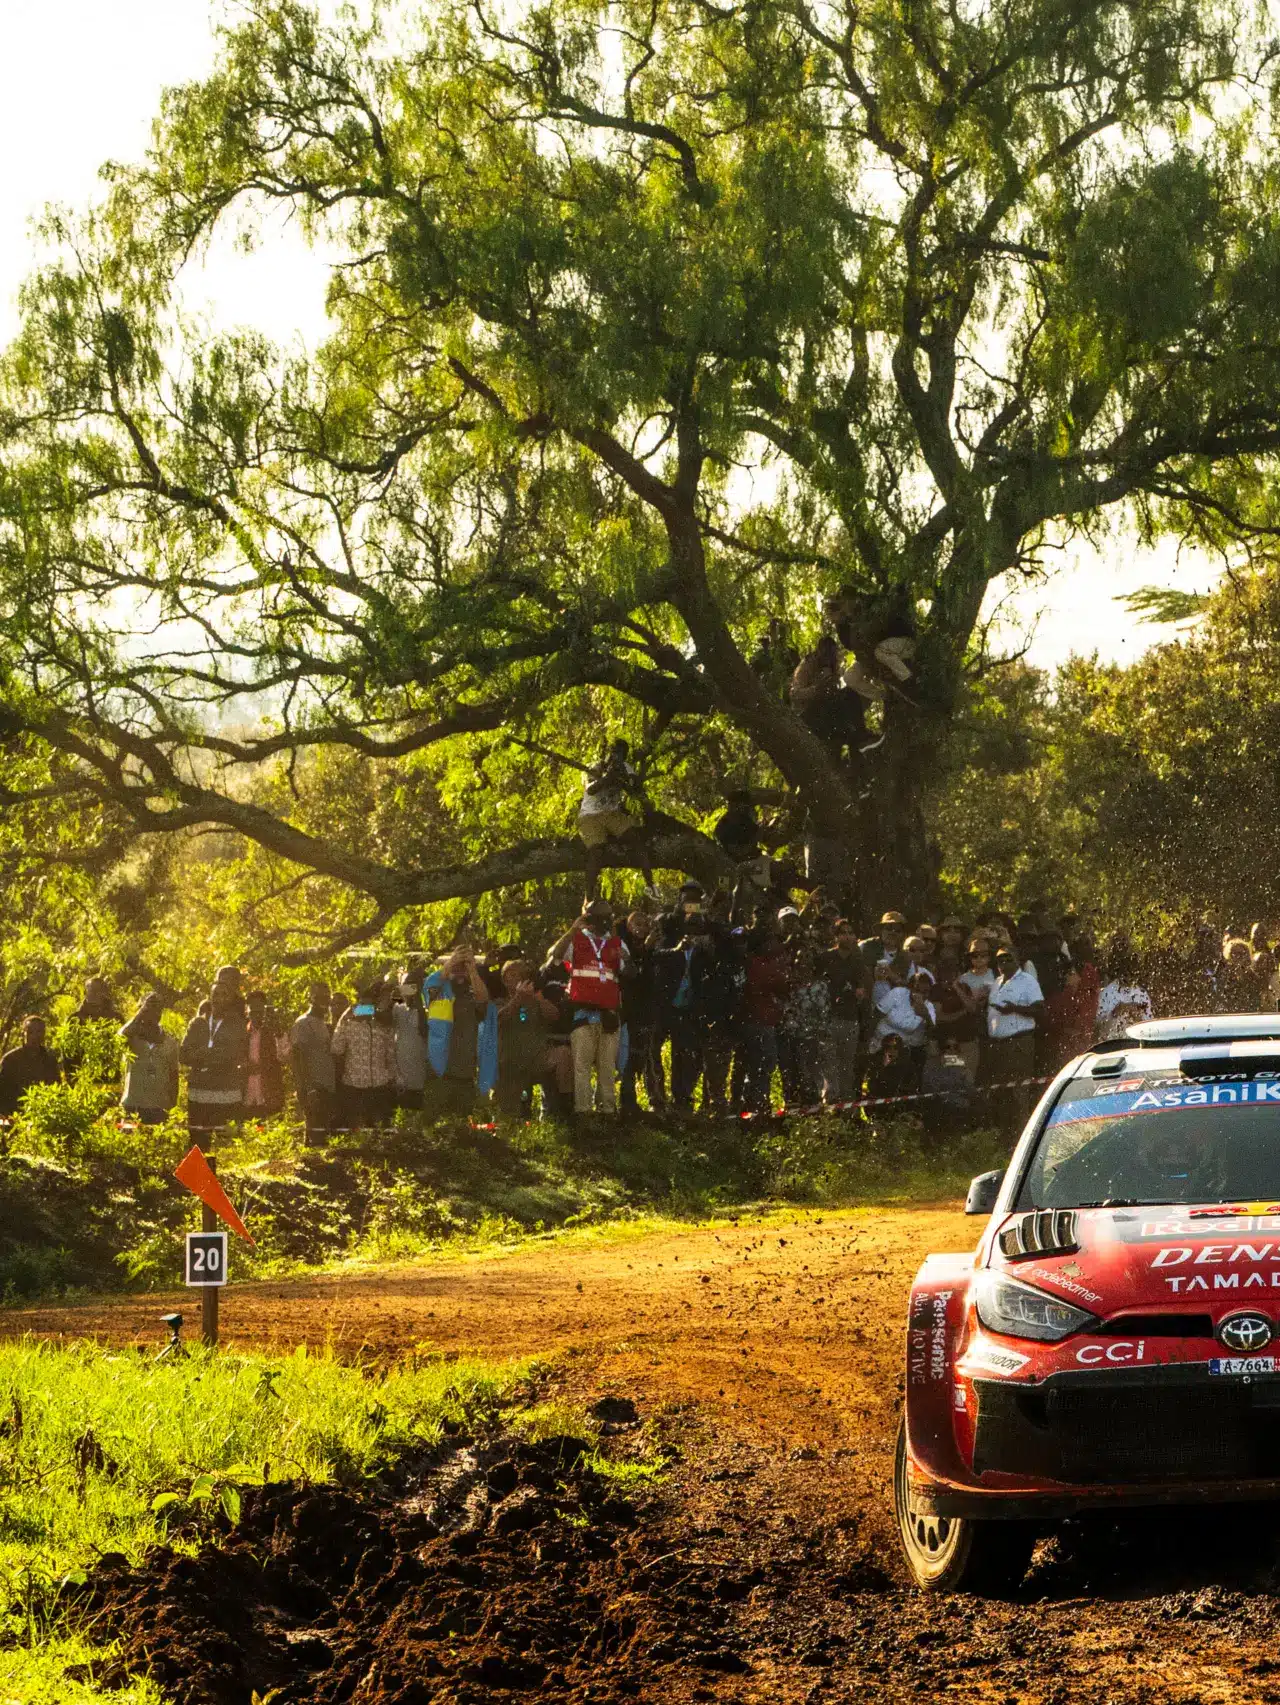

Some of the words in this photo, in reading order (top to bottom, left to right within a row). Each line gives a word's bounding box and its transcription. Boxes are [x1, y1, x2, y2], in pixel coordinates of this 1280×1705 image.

[1150, 1073, 1248, 1087] TOYOTA
[1141, 1216, 1253, 1237] Red
[193, 1247, 219, 1271] 20
[1032, 1268, 1100, 1303] codebeamer
[1223, 1359, 1270, 1373] A-7664
